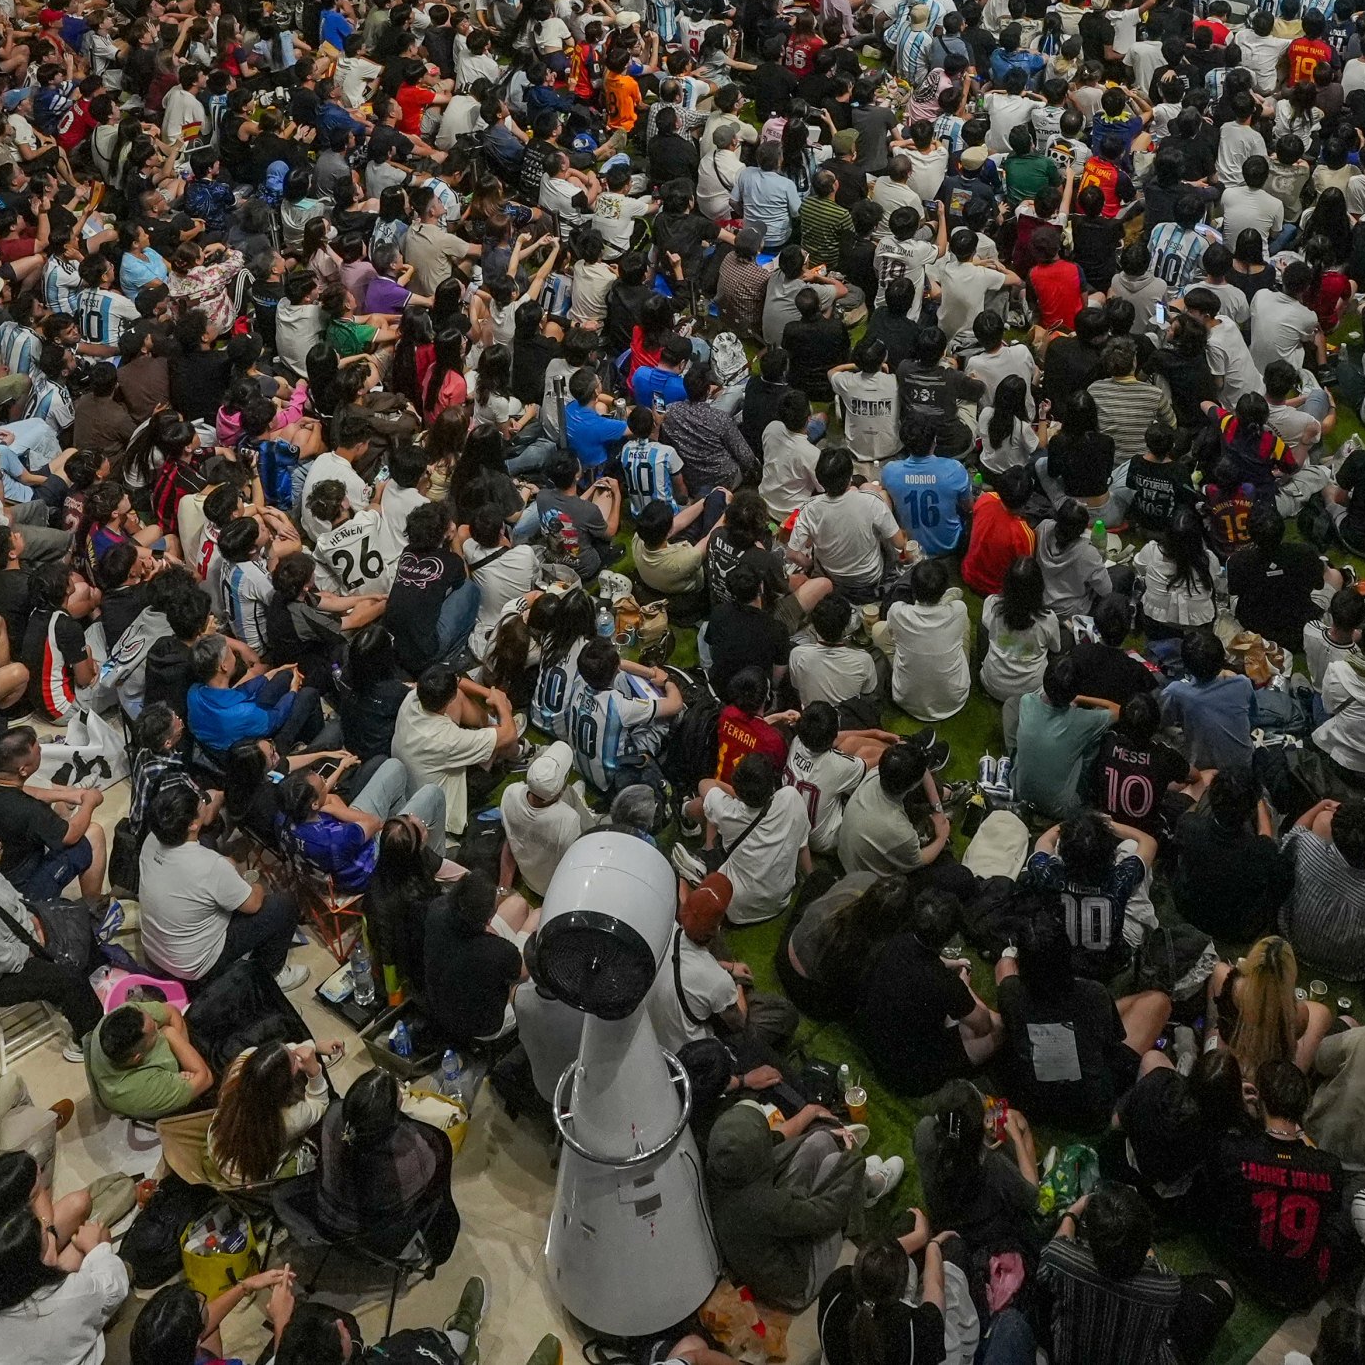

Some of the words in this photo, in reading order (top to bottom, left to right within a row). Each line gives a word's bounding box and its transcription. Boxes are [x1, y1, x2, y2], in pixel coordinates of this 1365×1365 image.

[1153, 247, 1183, 288] 10
[625, 461, 654, 497] 10
[904, 473, 937, 485] RODRIGO
[903, 489, 941, 528] 16
[329, 525, 363, 547] HEAVEN
[331, 535, 384, 592] 26
[722, 720, 756, 749] FERRAN
[1112, 744, 1150, 766] MESSI
[1105, 765, 1153, 818] 10
[1061, 891, 1112, 950] 10
[1251, 1190, 1321, 1258] 19
